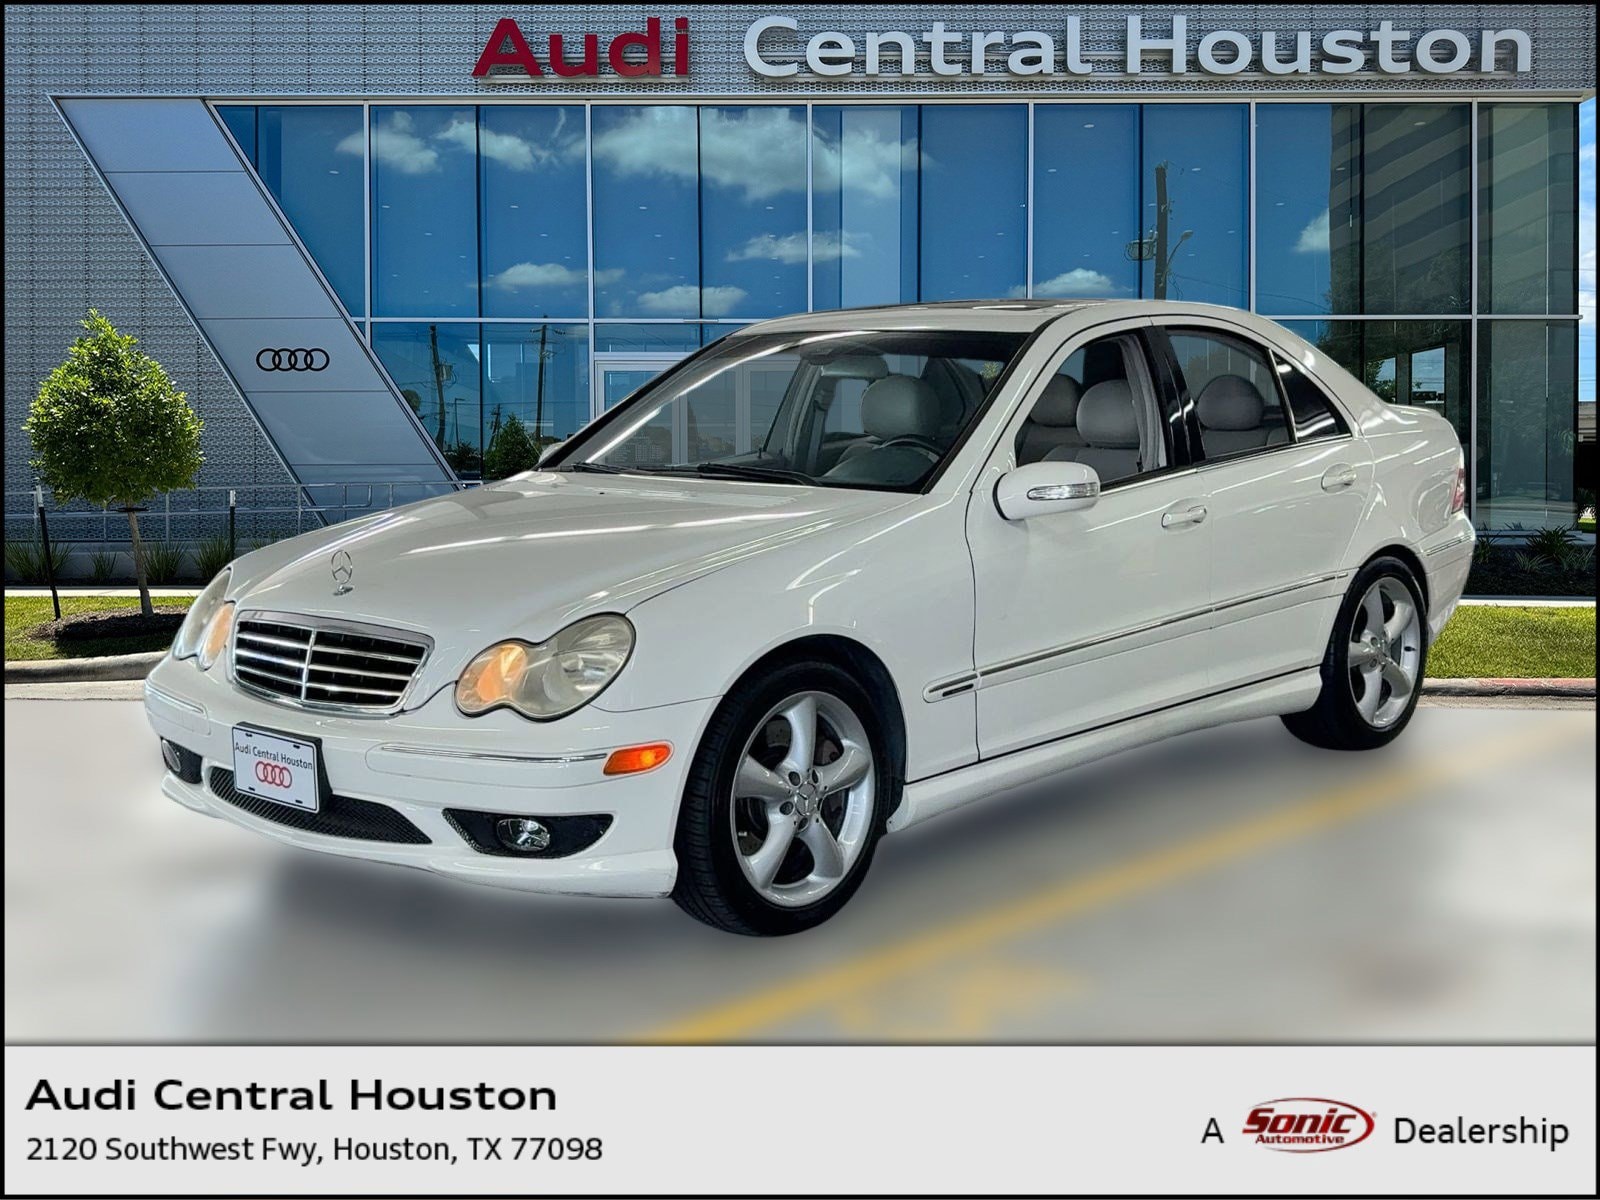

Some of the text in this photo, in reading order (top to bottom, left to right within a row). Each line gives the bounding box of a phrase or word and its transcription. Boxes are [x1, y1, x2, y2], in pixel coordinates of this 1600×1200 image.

[473, 15, 1532, 77] Audi Central Houston
[235, 741, 313, 770] Audi Central Houston
